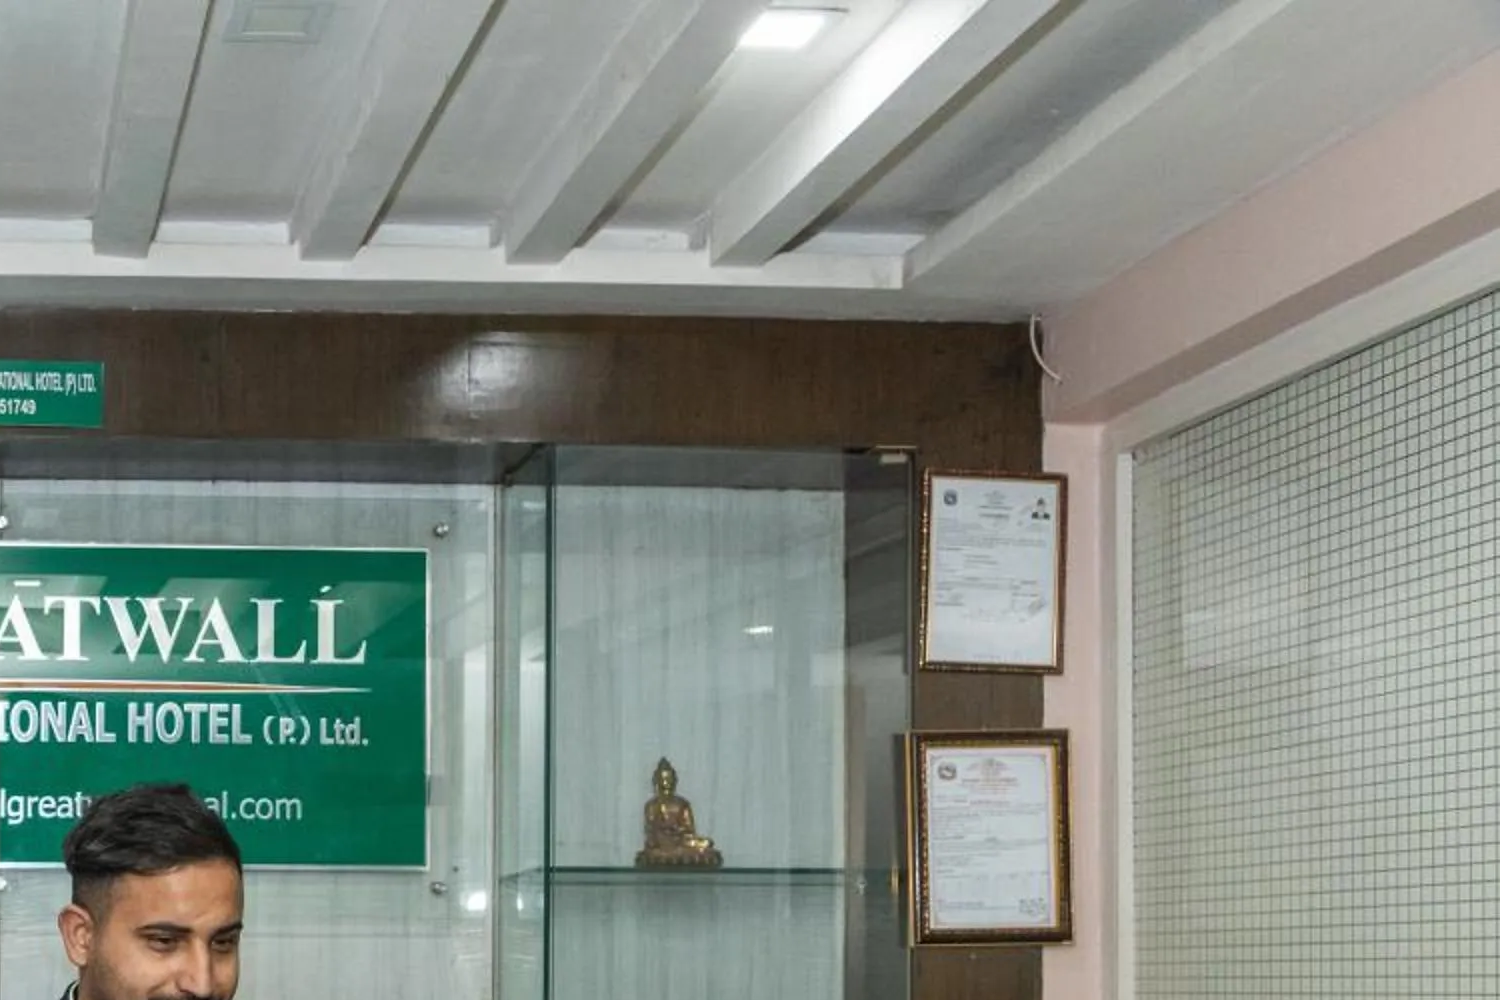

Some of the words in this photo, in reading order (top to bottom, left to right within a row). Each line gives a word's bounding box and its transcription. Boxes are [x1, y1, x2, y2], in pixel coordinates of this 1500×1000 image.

[35, 371, 64, 392] HOTEL
[127, 702, 252, 745] HOTEL
[319, 715, 369, 746] Ltd.
